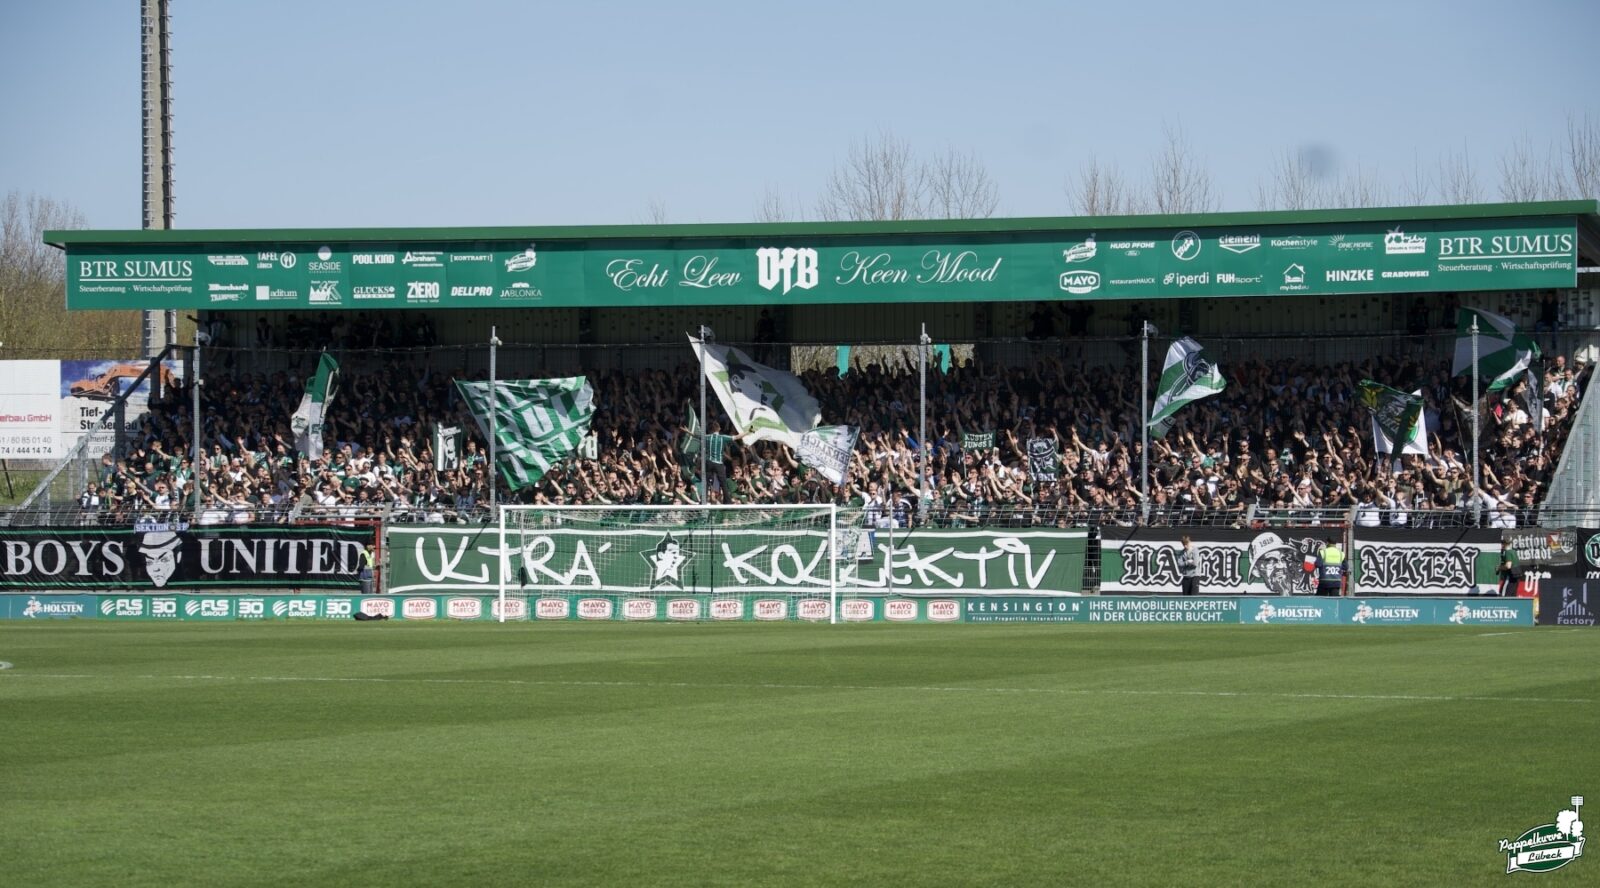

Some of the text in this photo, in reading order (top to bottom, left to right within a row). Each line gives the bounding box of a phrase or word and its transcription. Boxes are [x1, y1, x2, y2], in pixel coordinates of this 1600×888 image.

[1439, 236, 1483, 255] BTR
[1491, 234, 1573, 254] SUMUS
[257, 252, 279, 261] TAFEL
[80, 261, 119, 277] BTR
[124, 260, 193, 277] SUMUS
[308, 262, 342, 271] SEASIDE
[836, 250, 1002, 284] Keen Mood
[1438, 260, 1573, 273] Steuerberatung Wirtschaftsprüfung
[605, 258, 669, 291] Echt
[1176, 272, 1209, 287] iperdi
[1326, 269, 1374, 282] HINZKE
[1064, 275, 1096, 285] MAYO
[79, 285, 192, 294] Steuerberatung Wirtschaftsprüfung
[270, 289, 297, 297] aditum
[451, 286, 493, 296] DELLPRO
[499, 289, 542, 297] JABLONKA
[80, 407, 103, 417] Tief-
[27, 414, 52, 422] GmbH
[80, 420, 137, 430] Strßeau
[136, 524, 168, 532] SEKTION
[1511, 534, 1547, 549] ektion
[2, 539, 125, 576] BOYS
[197, 539, 366, 575] UNITED
[1326, 566, 1340, 575] 202
[43, 604, 83, 613] HOLSTEN
[116, 599, 143, 610] FLS
[152, 601, 176, 613] 30
[201, 600, 229, 611] FLS
[238, 602, 264, 614] 30
[288, 600, 316, 611] FLS
[326, 602, 351, 614] 30
[968, 602, 1079, 611] KENSINGTON
[1089, 601, 1237, 610] IHRE IMMOBILIENEXPERTEN
[1089, 610, 1224, 621] IN DER LÜBECKER BUCHT.
[1278, 608, 1322, 618] HOLSTEN
[1375, 609, 1419, 618] HOLSTEN
[1472, 610, 1517, 619] HOLSTEN
[1557, 617, 1595, 626] Factory
